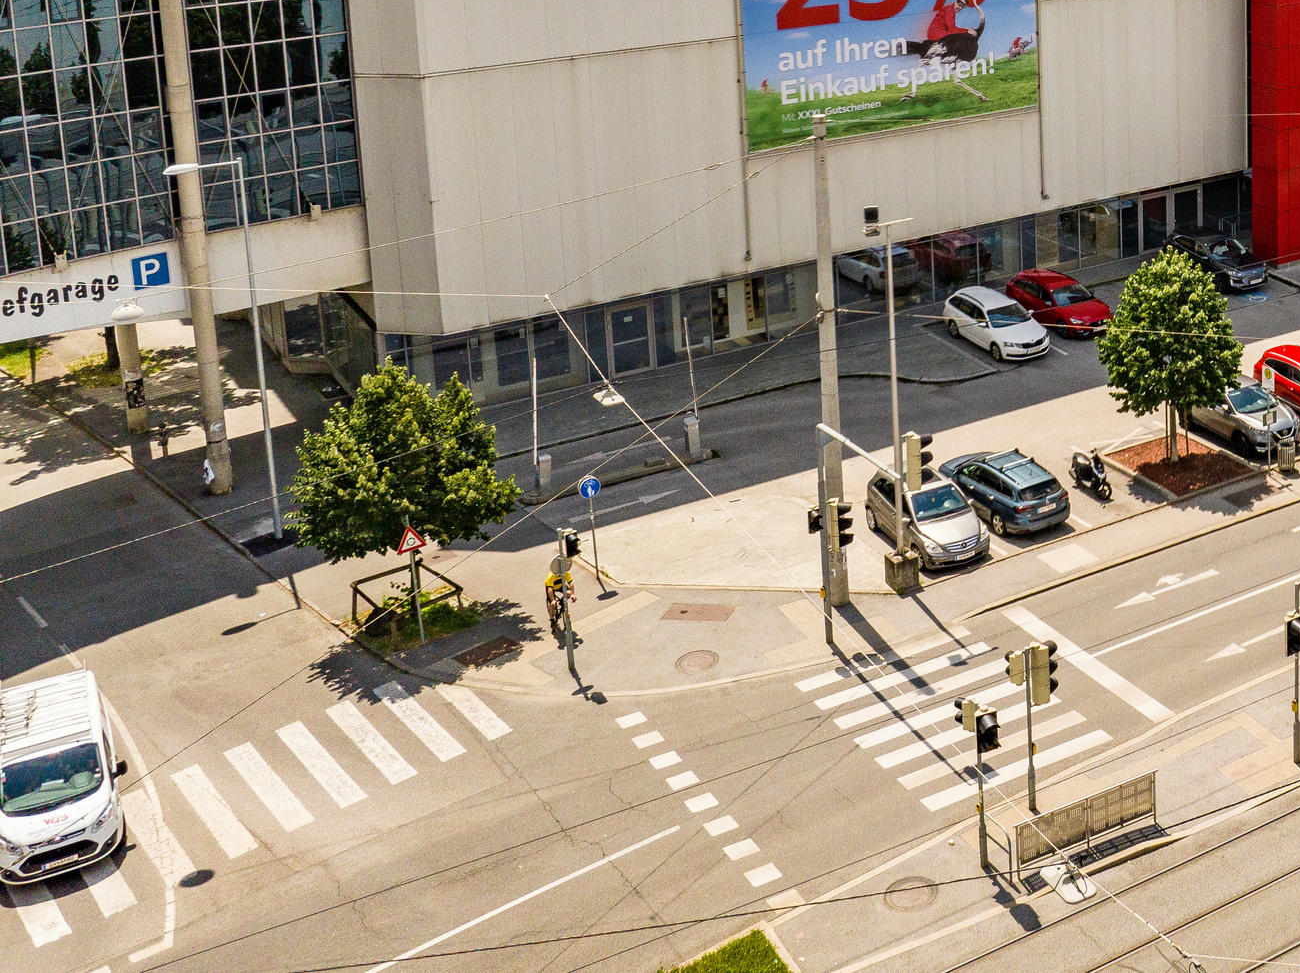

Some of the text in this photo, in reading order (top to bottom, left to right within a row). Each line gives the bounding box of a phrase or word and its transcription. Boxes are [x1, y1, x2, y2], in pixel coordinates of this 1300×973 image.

[777, 36, 908, 72] auf Ihren
[780, 51, 995, 106] Einkauf sparen!
[825, 100, 882, 116] Gutscheinen
[2, 258, 160, 317] efgarage P
